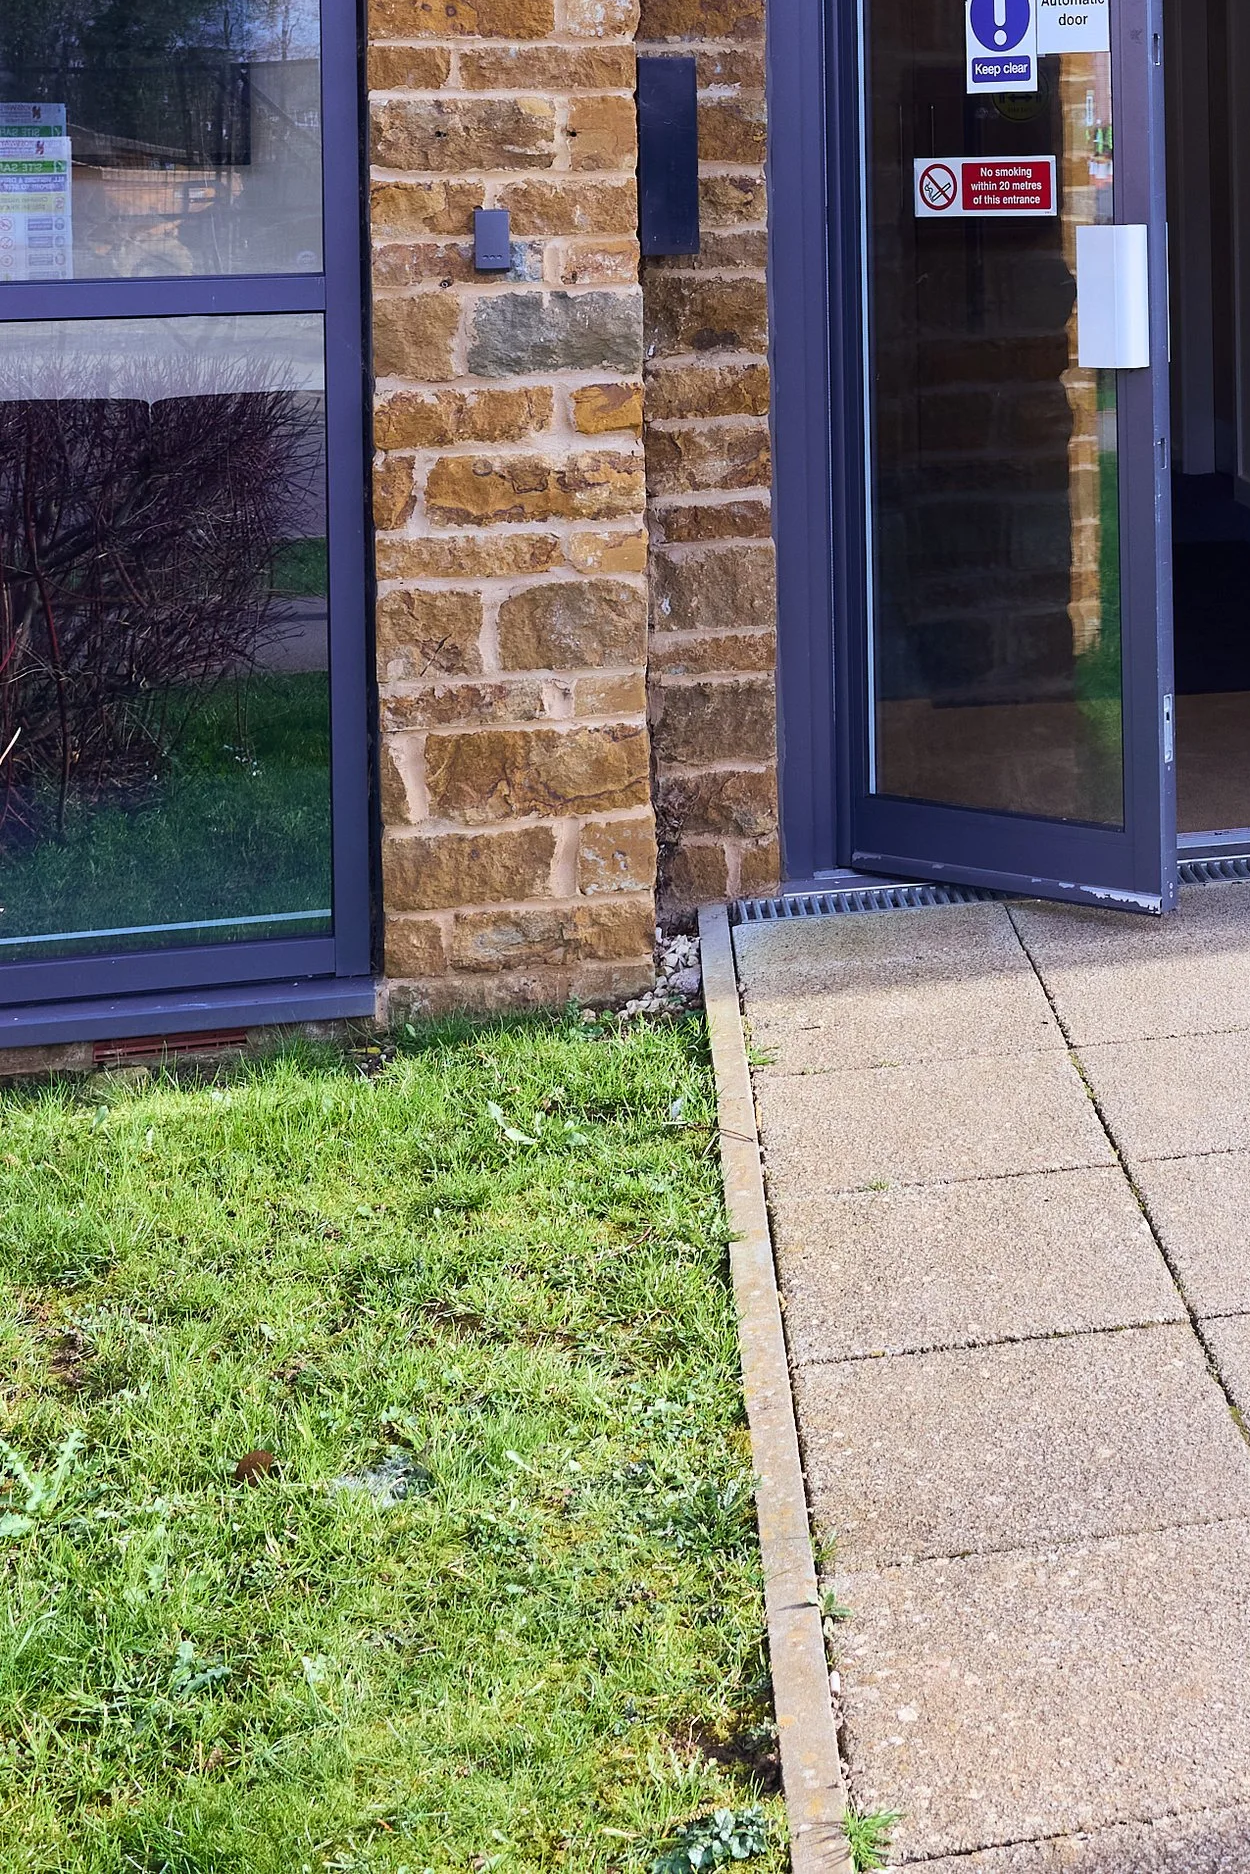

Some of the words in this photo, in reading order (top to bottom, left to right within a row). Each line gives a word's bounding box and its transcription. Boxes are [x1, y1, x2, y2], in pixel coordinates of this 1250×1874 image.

[1058, 12, 1089, 26] door
[974, 63, 1001, 77] Keep
[1003, 61, 1028, 74] clear
[980, 167, 993, 177] No
[994, 166, 1032, 179] smoking
[970, 181, 997, 191] within
[999, 180, 1010, 191] 20
[1012, 180, 1042, 191] metres
[972, 195, 982, 205] of
[983, 194, 1000, 205] this
[1002, 194, 1041, 205] entrance
